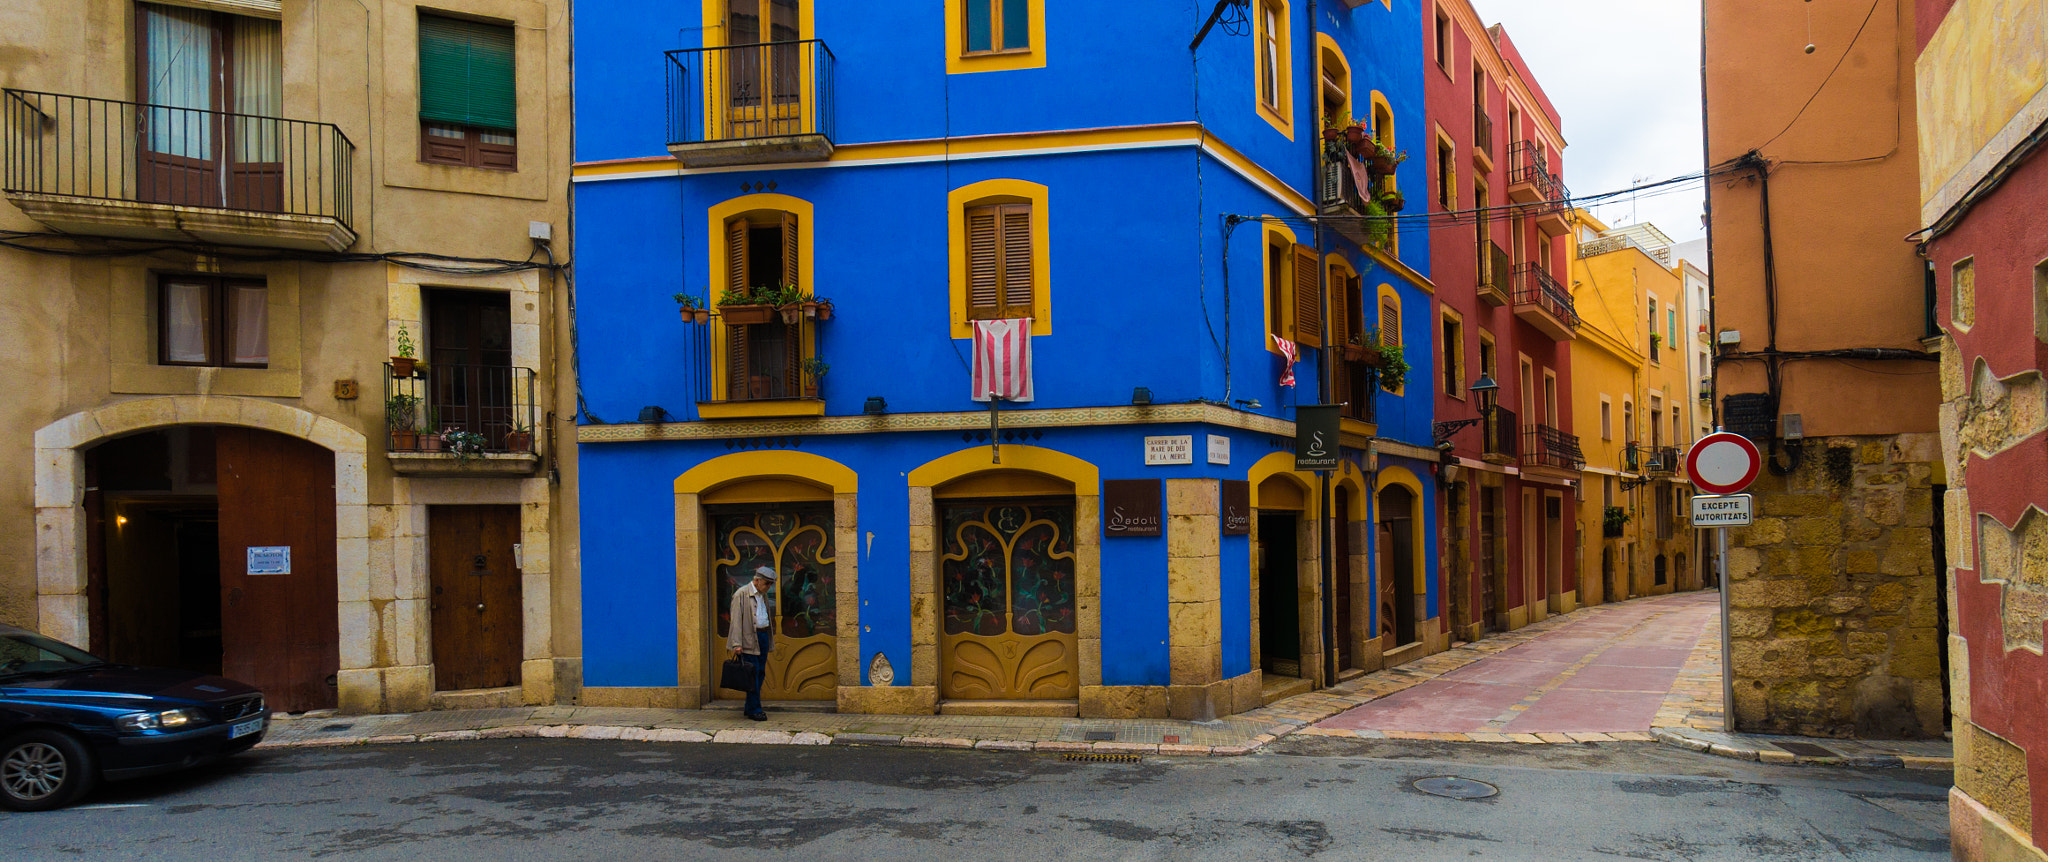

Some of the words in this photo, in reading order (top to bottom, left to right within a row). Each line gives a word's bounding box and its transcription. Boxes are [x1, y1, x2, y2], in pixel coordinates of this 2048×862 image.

[342, 384, 350, 396] 3
[1701, 501, 1740, 510] EXCEPTE
[1694, 512, 1748, 521] AUTORITZATS
